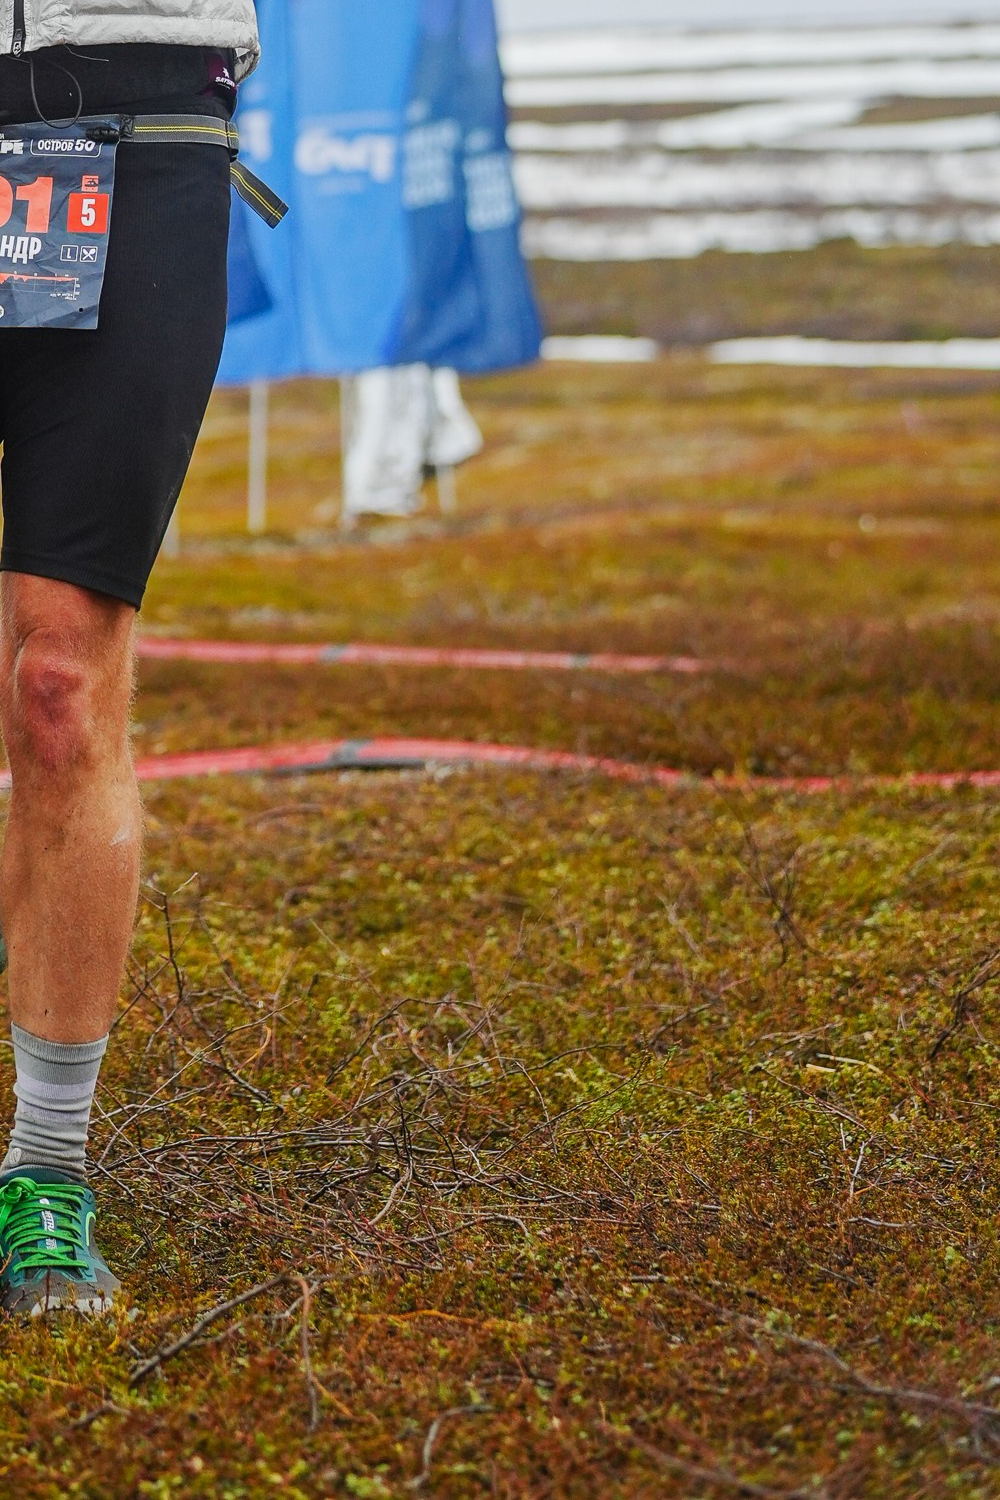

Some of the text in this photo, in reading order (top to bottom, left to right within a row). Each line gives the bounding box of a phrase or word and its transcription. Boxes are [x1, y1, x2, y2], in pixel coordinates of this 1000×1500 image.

[37, 139, 96, 152] ОСТРОВ 50
[81, 198, 96, 226] 5
